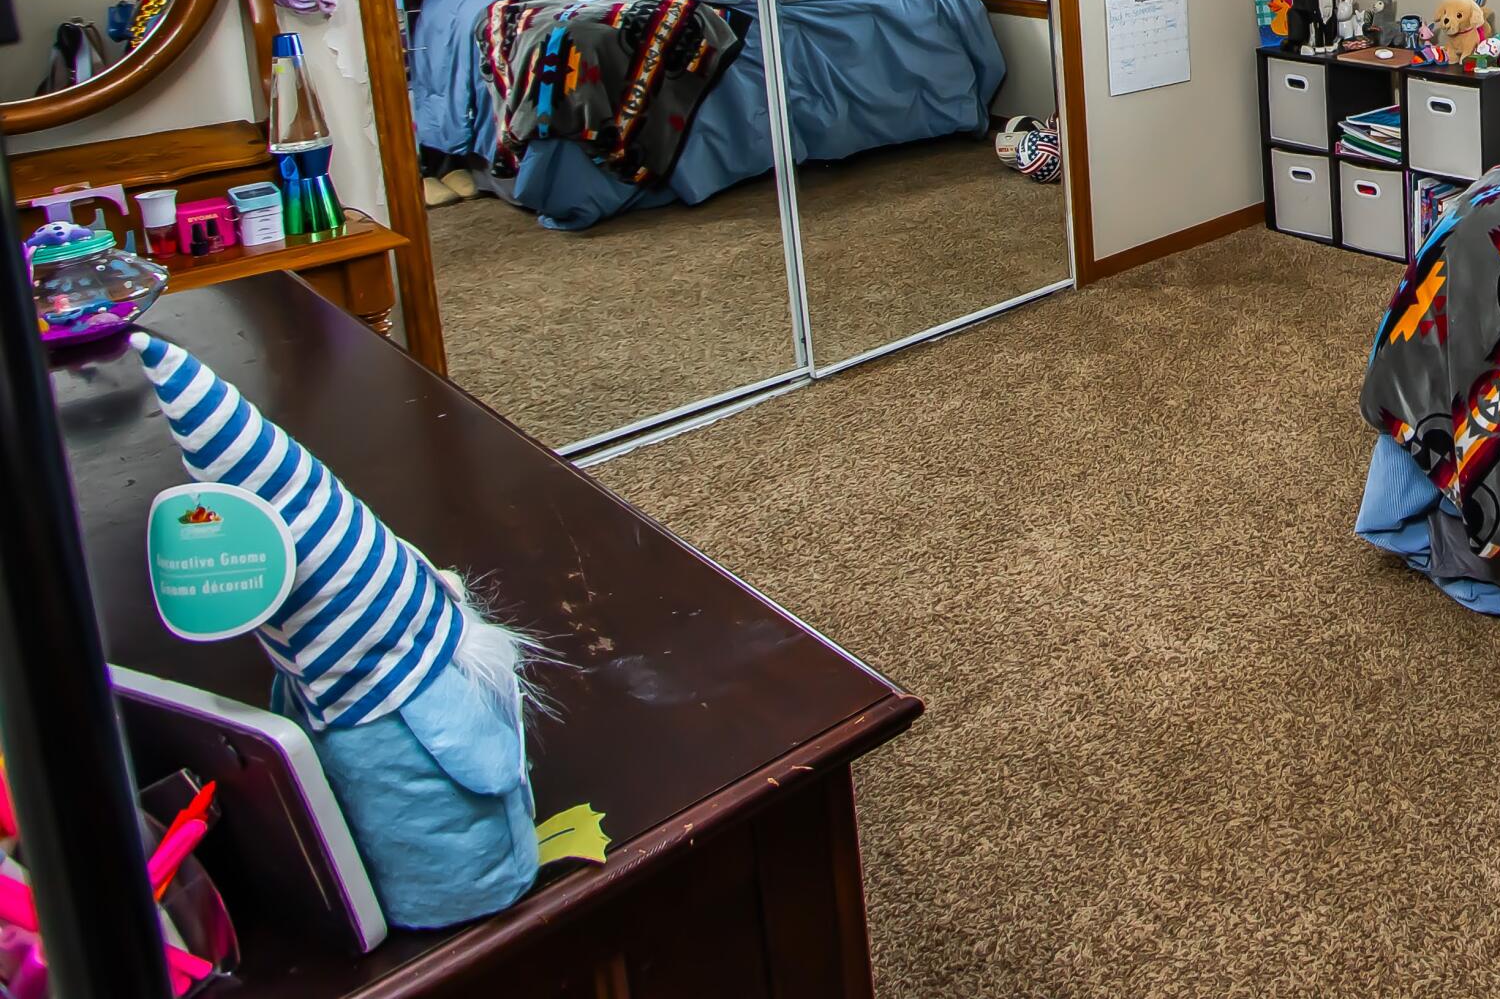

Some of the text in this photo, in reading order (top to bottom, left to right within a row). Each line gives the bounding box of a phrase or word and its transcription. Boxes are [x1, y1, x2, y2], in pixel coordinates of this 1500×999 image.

[220, 551, 267, 567] Gnome
[160, 574, 264, 597] Gnome décoratif
